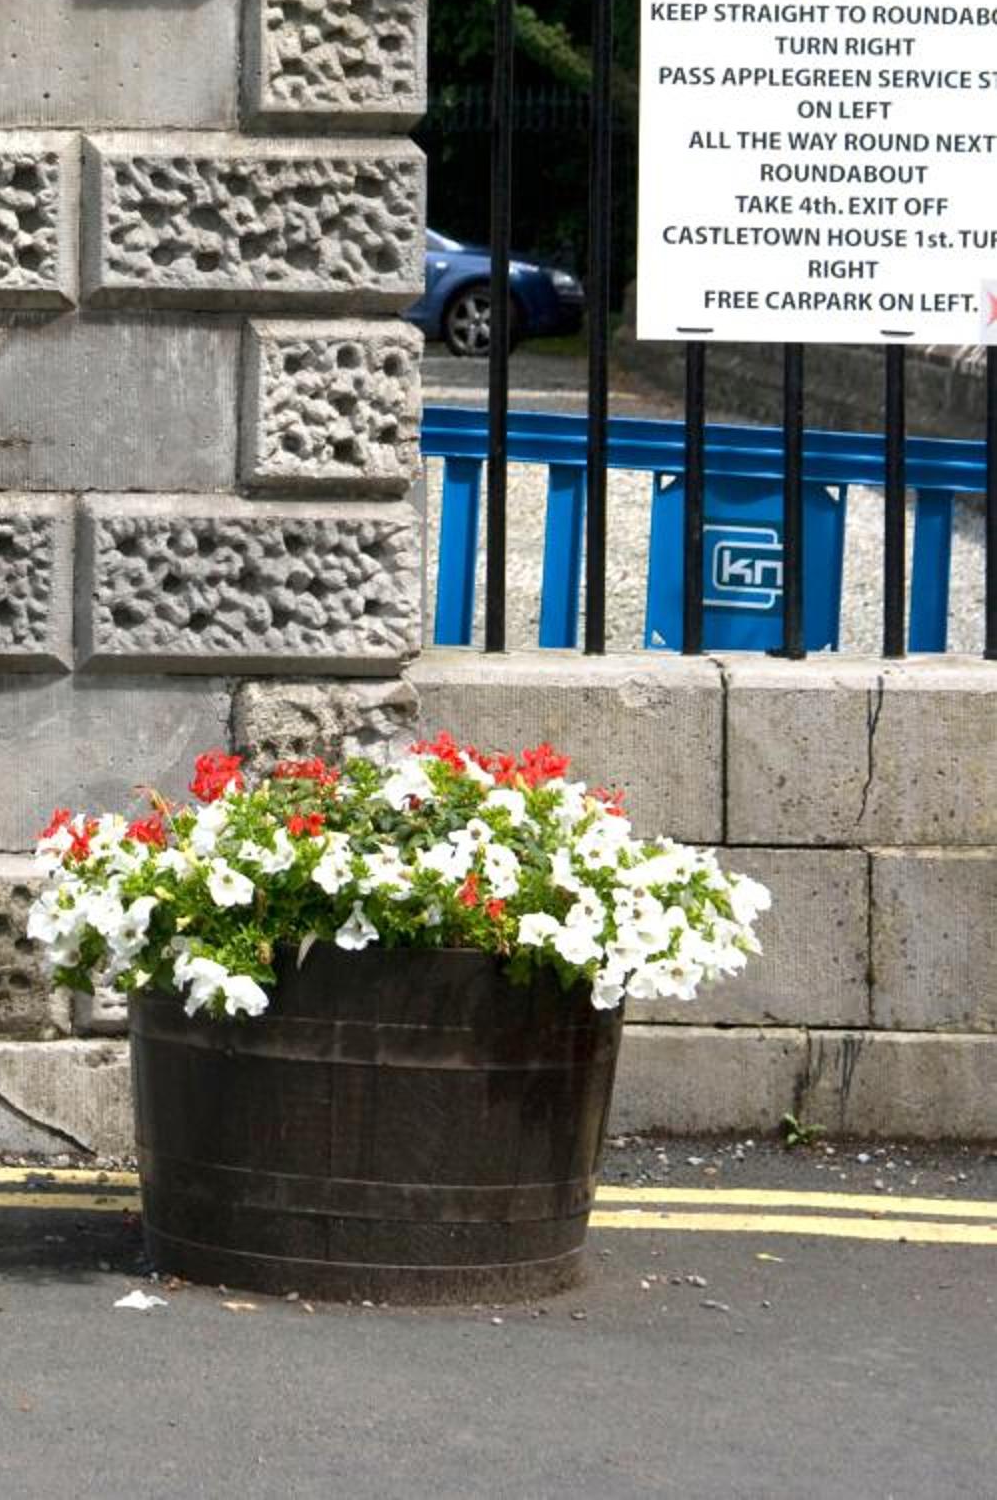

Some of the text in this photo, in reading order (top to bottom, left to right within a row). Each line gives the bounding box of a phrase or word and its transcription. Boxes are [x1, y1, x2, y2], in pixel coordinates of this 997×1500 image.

[651, 3, 707, 21] KEEP
[715, 4, 829, 23] STRAIGHT
[835, 5, 866, 23] TO
[775, 36, 915, 56] TURN RIGHT
[659, 67, 715, 85] PASS
[722, 67, 871, 87] APPLEGREEN
[879, 70, 971, 89] SERVICE
[797, 100, 891, 119] ON LEFT
[689, 131, 997, 153] ALL THE WAY ROUND NEXT
[761, 164, 928, 184] ROUNDABOUT
[735, 196, 947, 216] TAKE 4th. EXIT OFF
[663, 226, 820, 246] CASTLETOWN
[828, 228, 907, 247] HOUSE
[915, 230, 953, 248] 1st.
[809, 260, 879, 279] RIGHT
[705, 290, 978, 312] FREE CARPARK ON LEFT.
